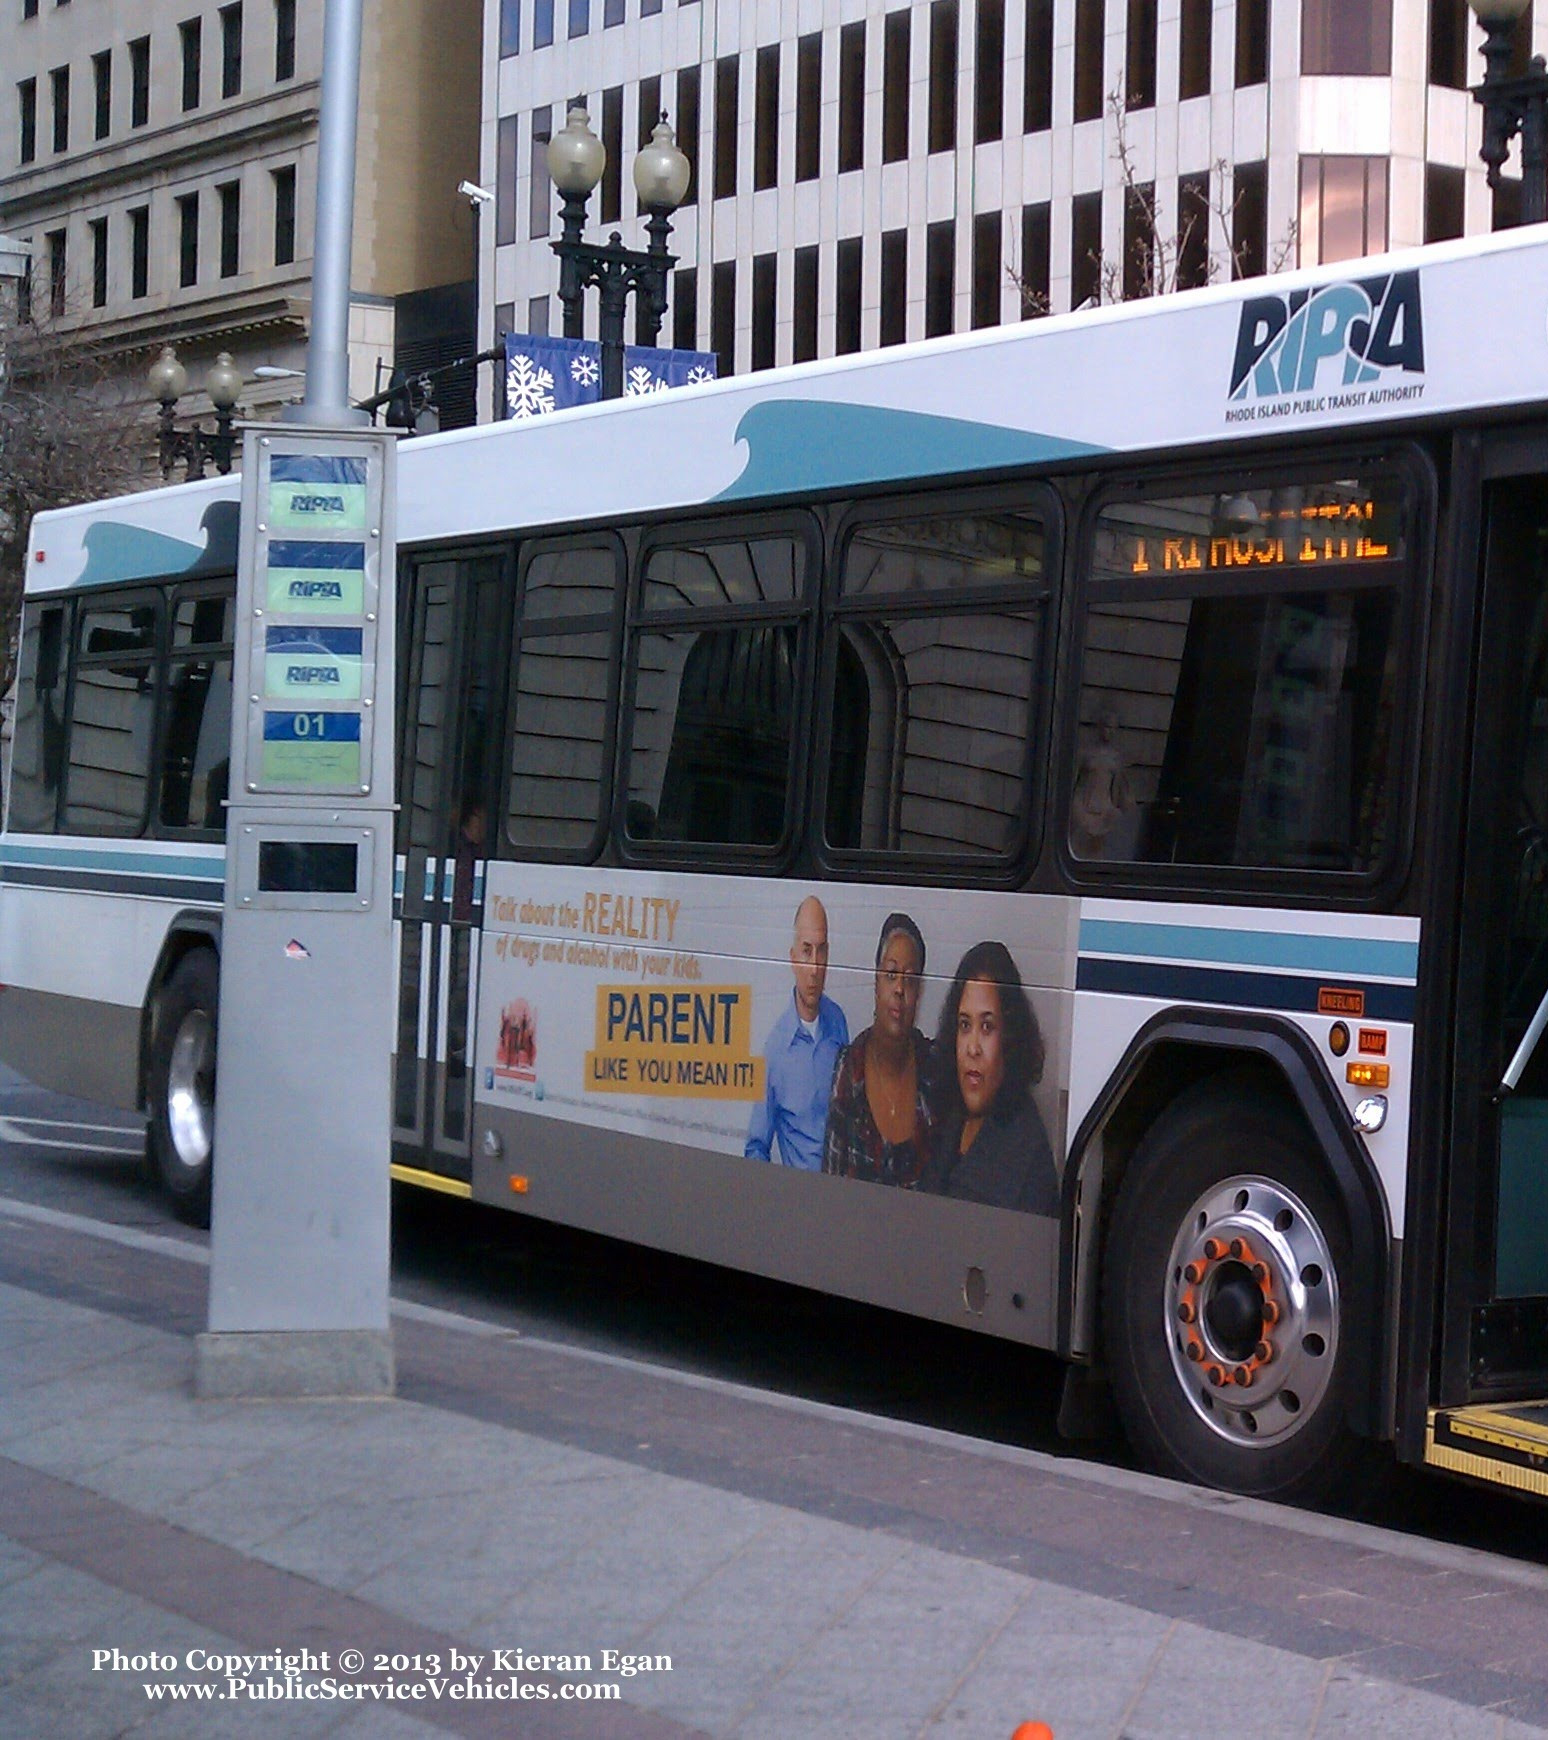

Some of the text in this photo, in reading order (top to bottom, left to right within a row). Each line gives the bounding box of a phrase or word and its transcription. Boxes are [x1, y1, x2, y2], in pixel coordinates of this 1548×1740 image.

[1227, 268, 1426, 400] RIPTA
[1225, 384, 1425, 423] RHODE ISLAND PUBLIC TRANSIT AUTHORITY
[289, 580, 342, 597] RIPTA
[286, 666, 340, 682] RIPTA
[293, 713, 325, 737] 01
[492, 891, 681, 942] Talk about the REALITY
[496, 933, 510, 961] of
[511, 934, 540, 967] drugs
[543, 940, 565, 963] and
[566, 941, 610, 968] alcohol
[612, 946, 639, 972] with
[641, 953, 671, 980] your
[1321, 993, 1361, 1011] KNEELING
[607, 992, 739, 1046] PARENT
[1361, 1034, 1385, 1050] RAMP
[593, 1057, 754, 1088] LIKE YOU MEAN IT!
